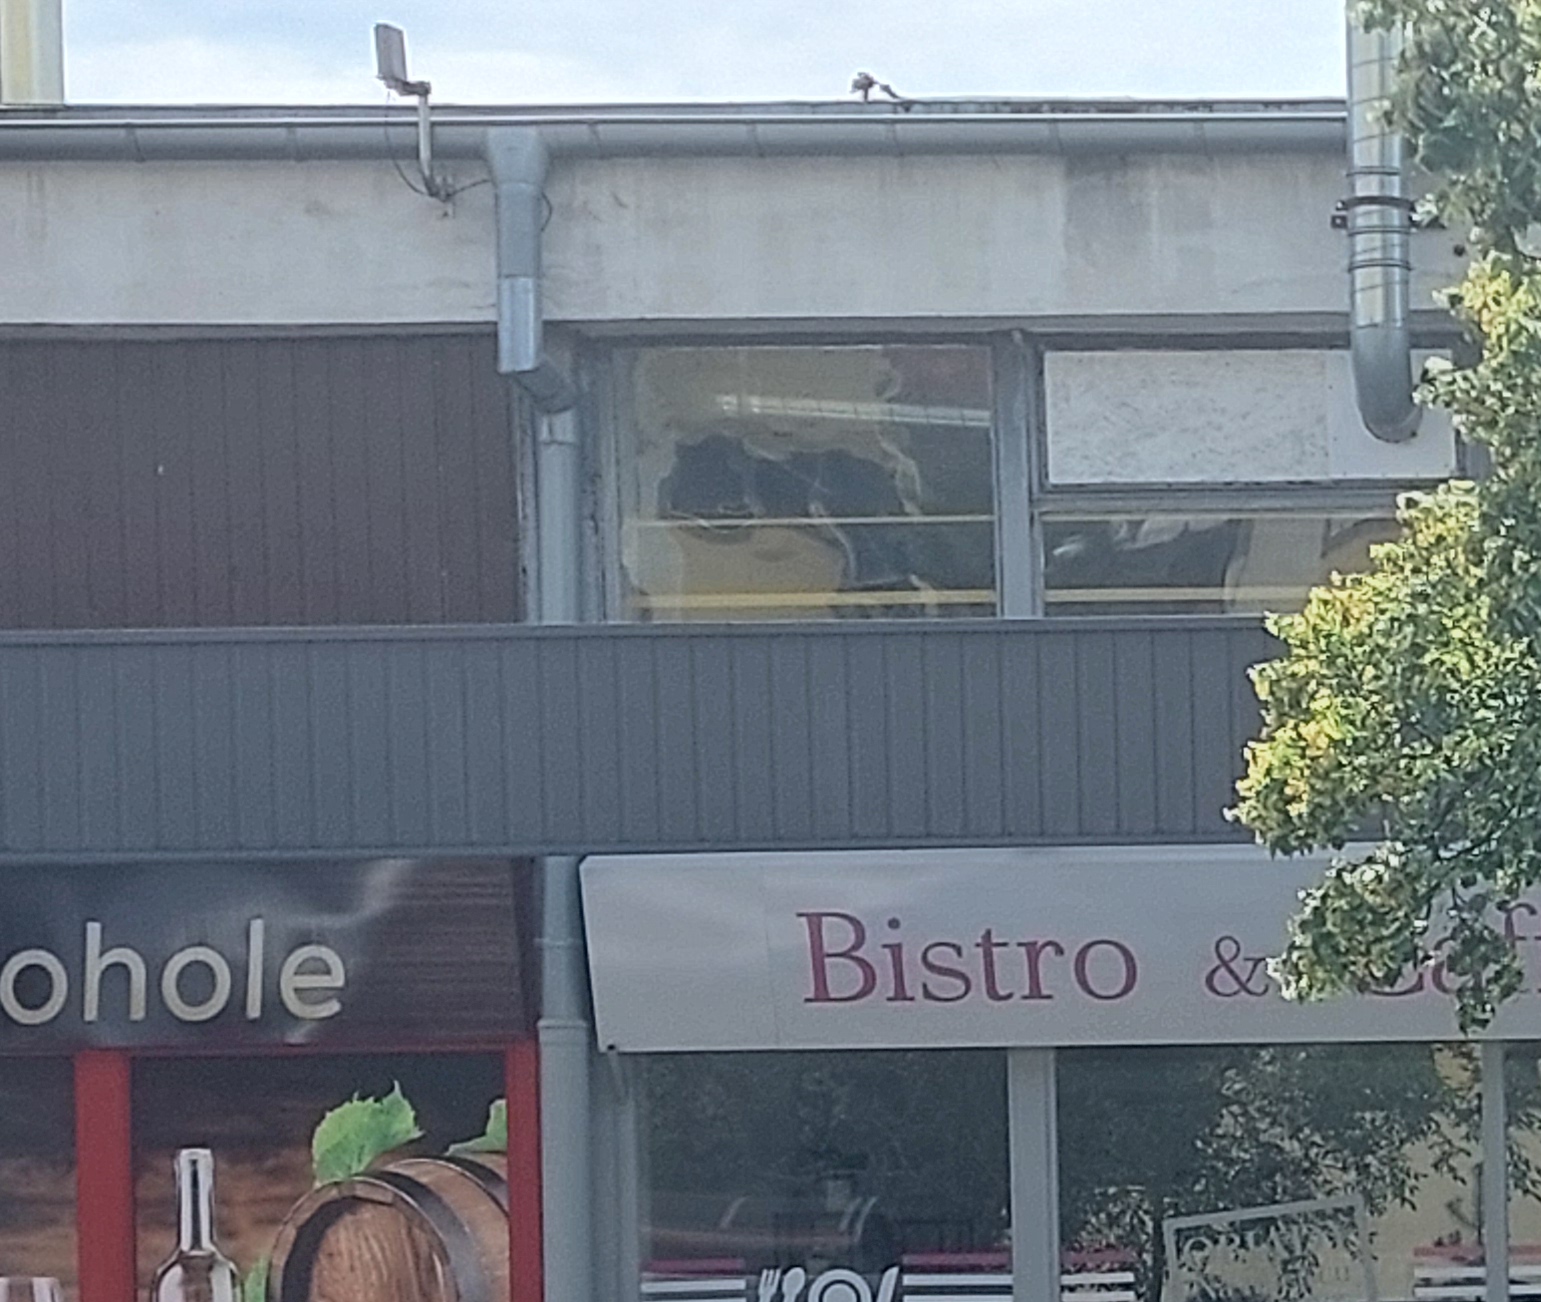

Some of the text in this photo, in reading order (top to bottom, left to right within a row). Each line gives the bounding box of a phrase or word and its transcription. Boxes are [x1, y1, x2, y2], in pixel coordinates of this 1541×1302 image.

[1, 918, 346, 1025] ohole
[796, 911, 1138, 1003] Bistro
[1204, 935, 1271, 999] &
